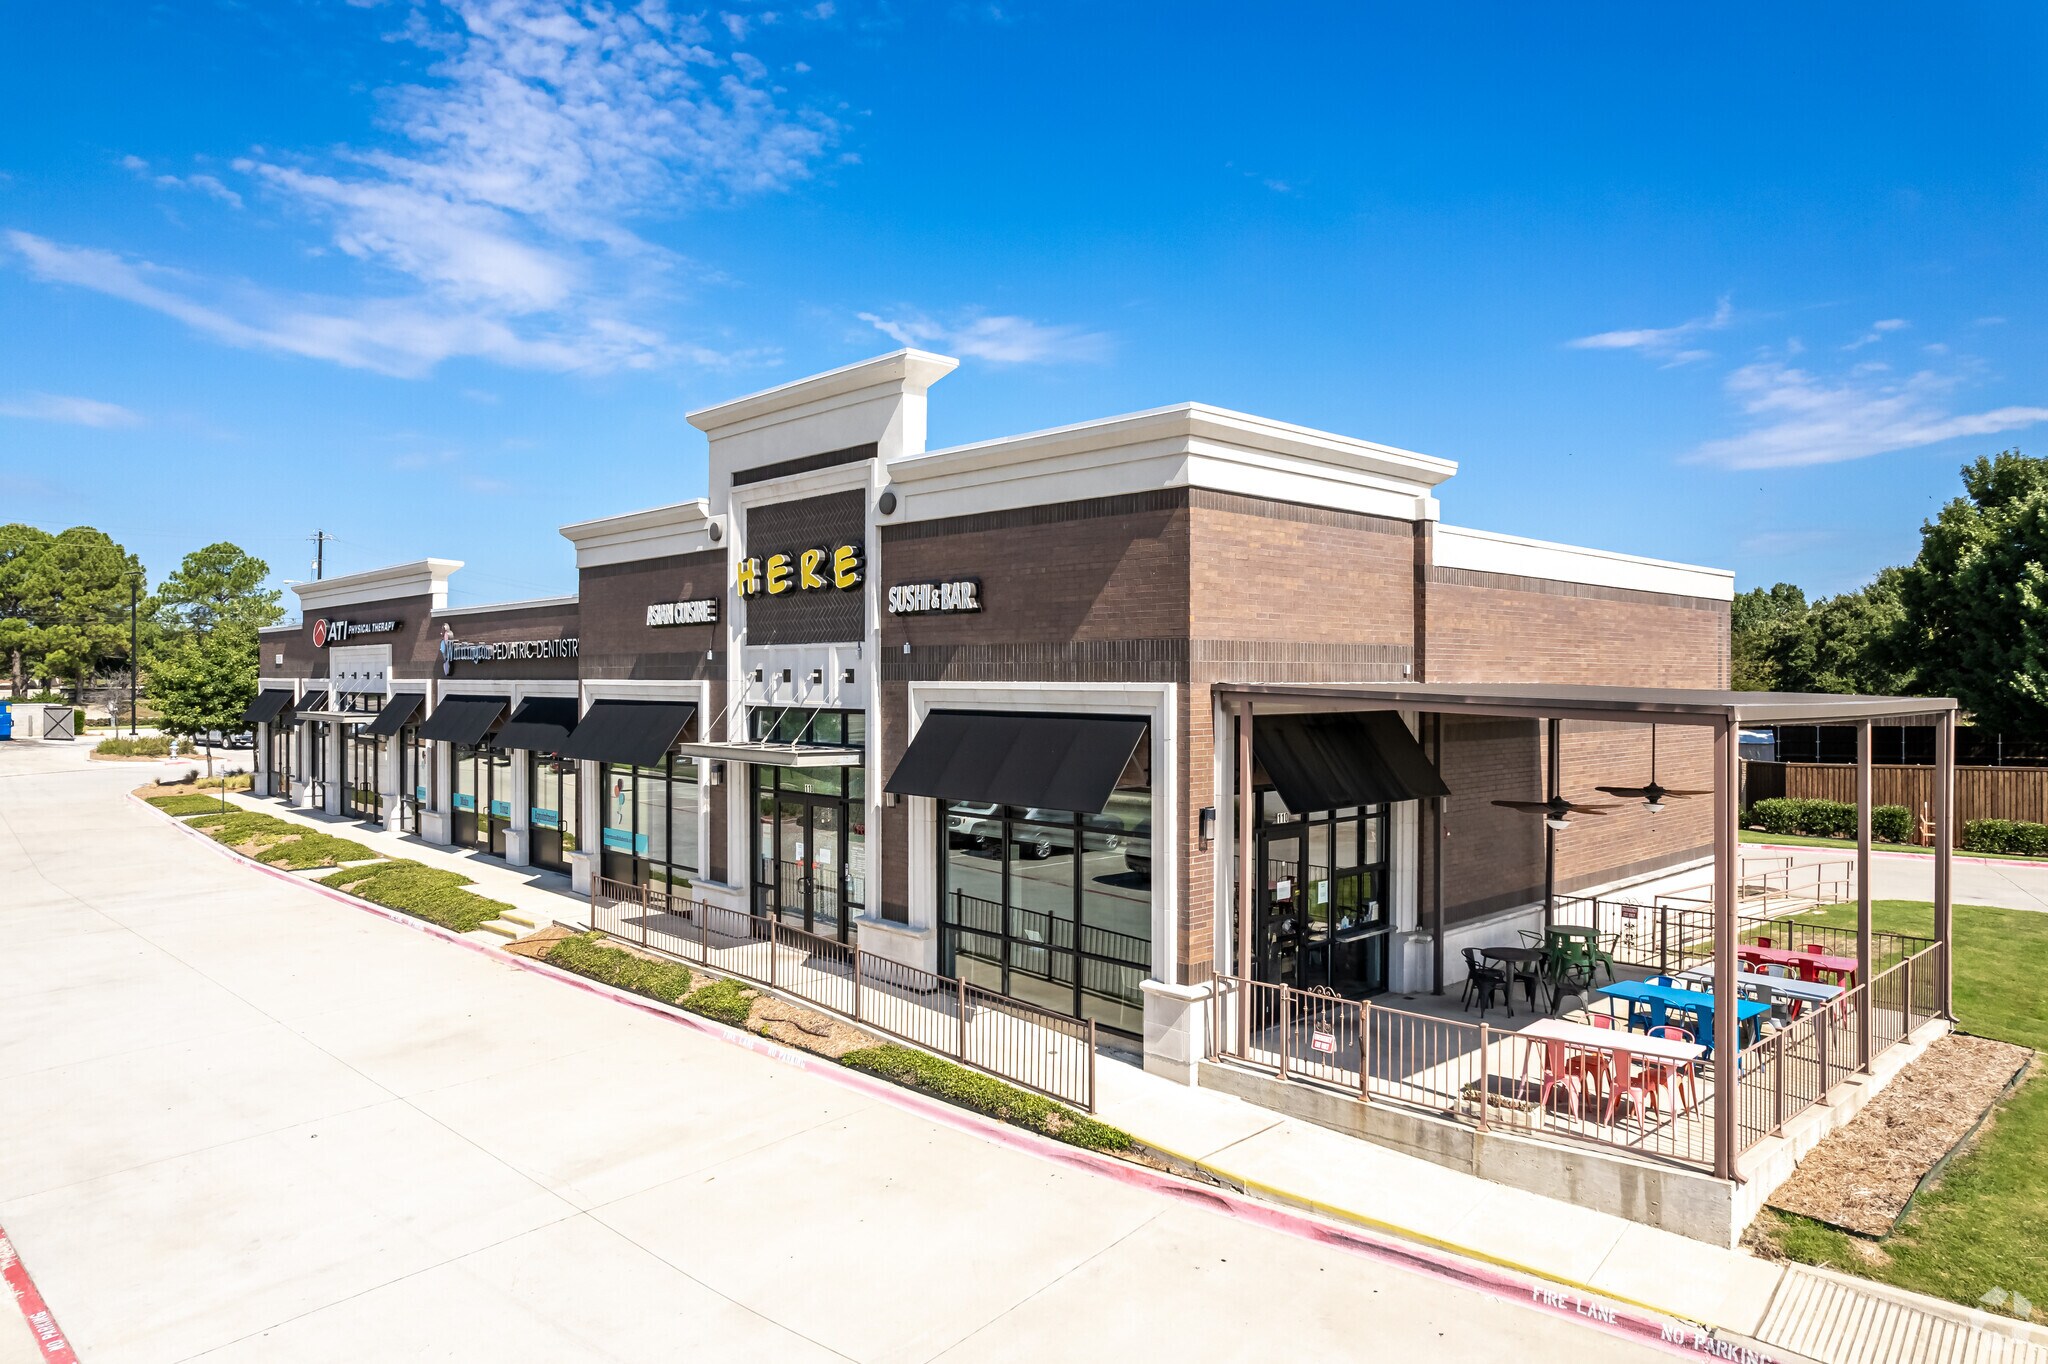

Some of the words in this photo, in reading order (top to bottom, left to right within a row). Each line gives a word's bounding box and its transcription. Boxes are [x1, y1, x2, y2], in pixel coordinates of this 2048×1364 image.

[737, 545, 858, 597] HERE
[888, 583, 931, 613] SUSHI
[930, 588, 941, 609] &
[941, 581, 974, 610] BAR
[646, 604, 675, 626] ASIAN
[675, 600, 716, 624] CUISINE
[327, 620, 348, 641] ATI
[348, 623, 371, 634] PHYSICAL
[372, 621, 396, 632] THERAPY
[492, 641, 535, 660] PEDIATRIC
[536, 638, 580, 659] DENTISTR
[1532, 1285, 1569, 1310] FIRE
[1576, 1299, 1621, 1325] LANE
[1661, 1322, 1684, 1345] NO
